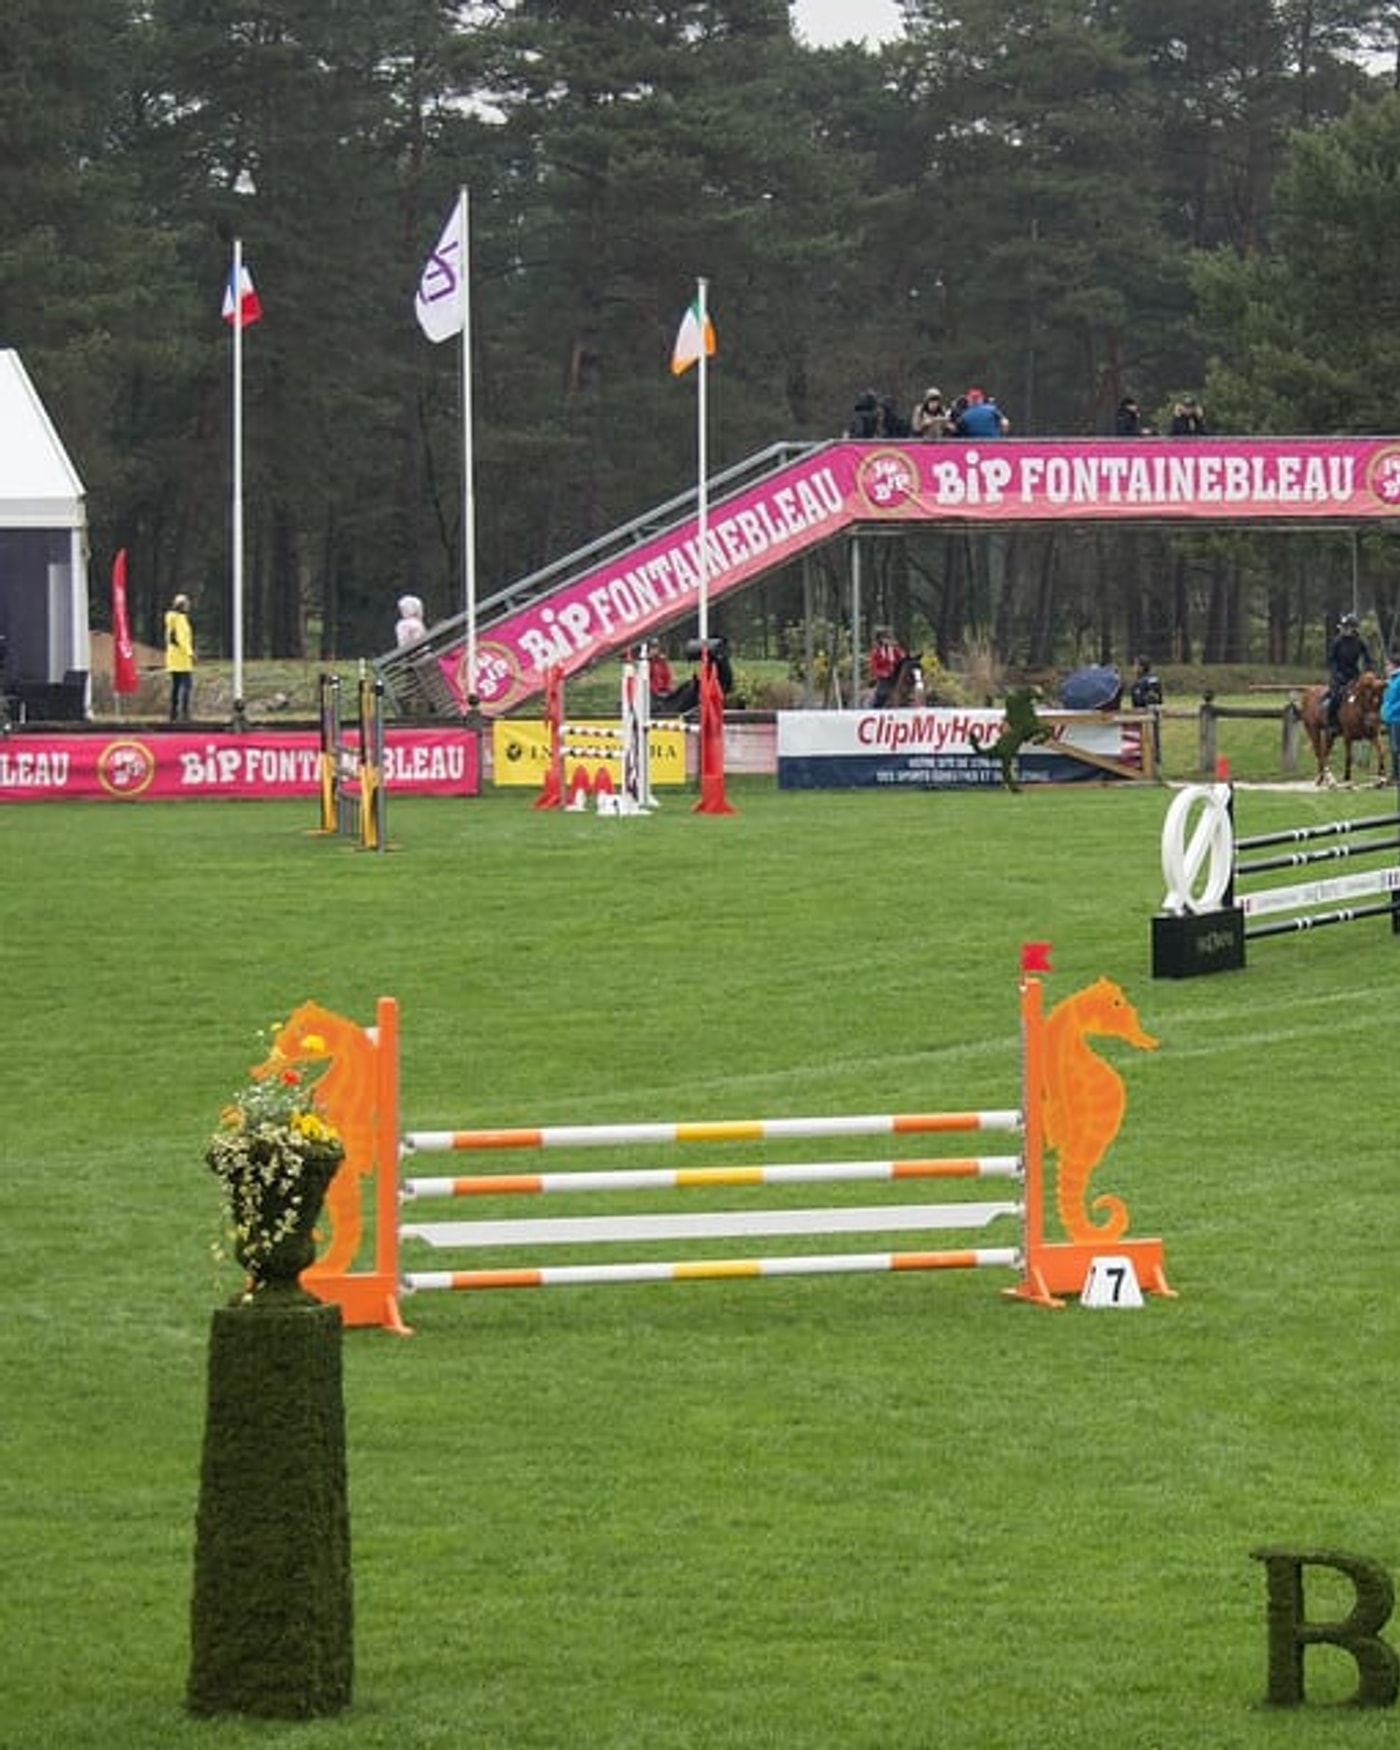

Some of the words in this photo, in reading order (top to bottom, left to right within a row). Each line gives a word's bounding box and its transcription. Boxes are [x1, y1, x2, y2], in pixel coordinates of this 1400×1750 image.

[933, 450, 1012, 504] BiP
[1020, 456, 1355, 502] FONTAINEBLEAU
[518, 602, 594, 673] BiP
[589, 468, 845, 636] FONTAINEBLEAU
[180, 744, 243, 785] BiP
[1106, 1267, 1126, 1302] 7
[1249, 1547, 1400, 1708] B
